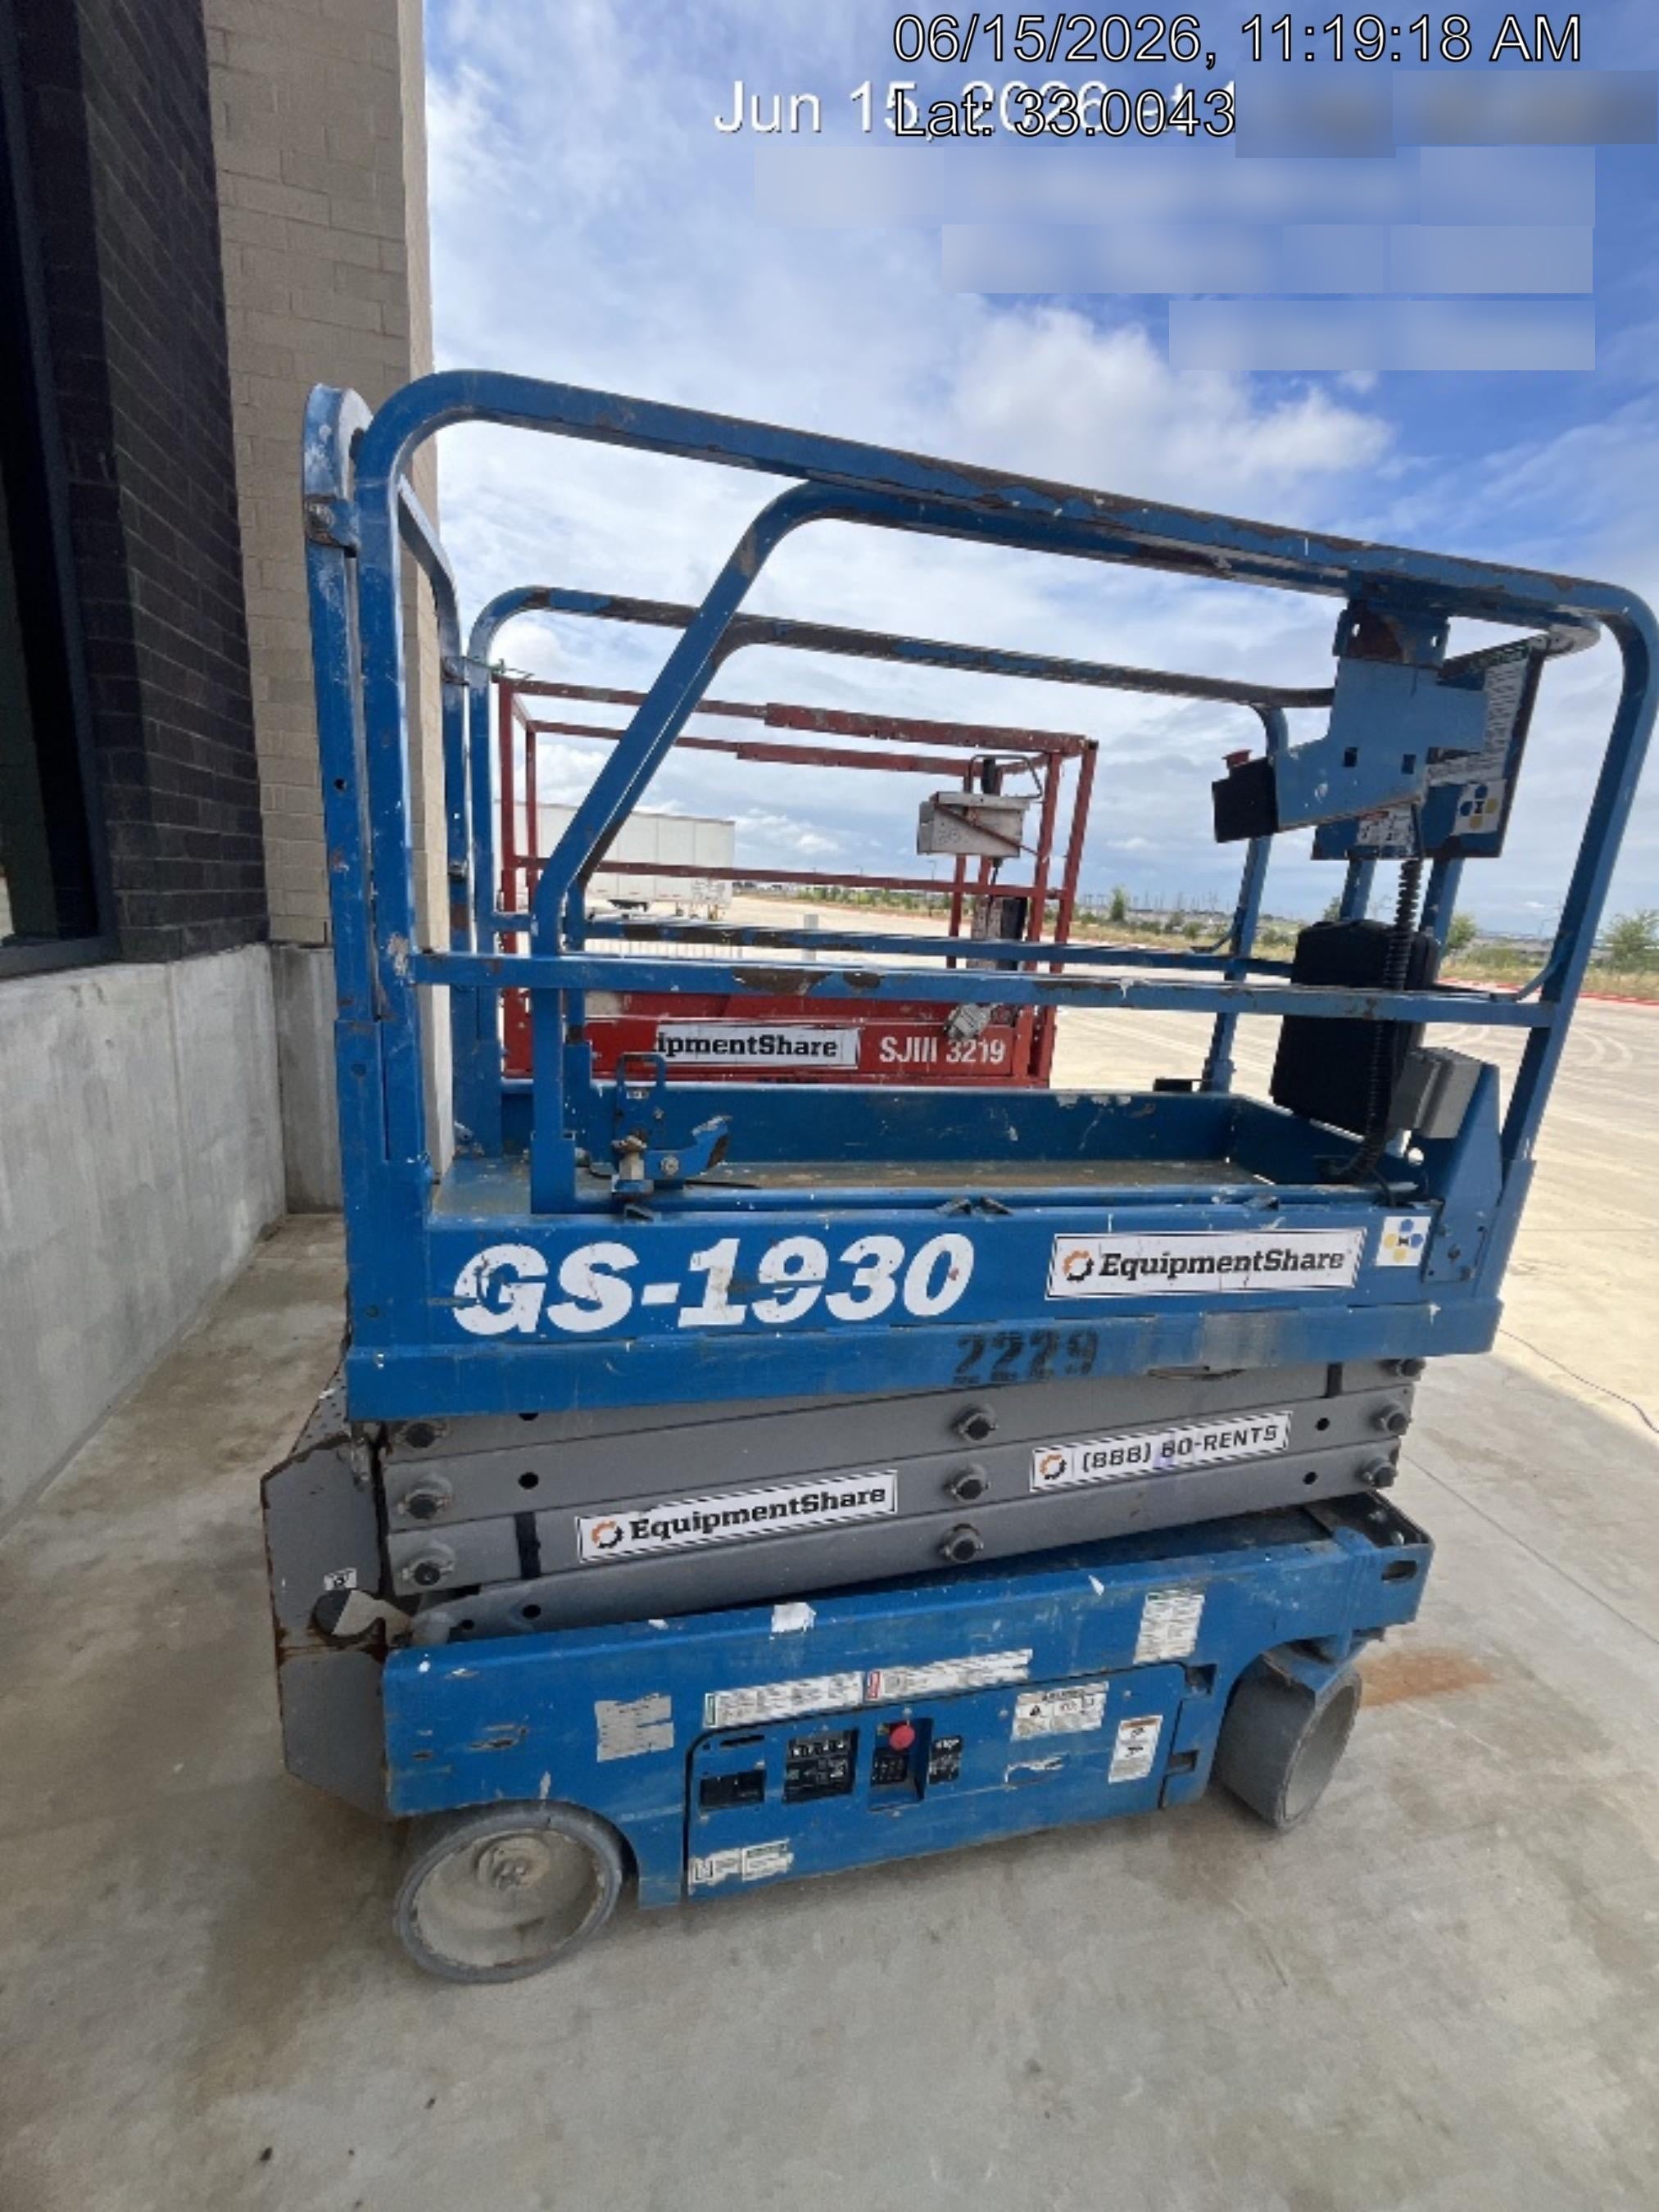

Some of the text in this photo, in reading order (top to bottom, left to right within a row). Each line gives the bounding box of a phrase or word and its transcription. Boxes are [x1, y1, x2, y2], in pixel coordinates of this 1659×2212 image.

[945, 1038, 1006, 1063] 3219
[1098, 1249, 1345, 1281] EquipmentShare
[453, 1233, 975, 1335] GS-1930
[1082, 1442, 1151, 1473] (888)
[629, 1488, 886, 1541] EquipmentShare
